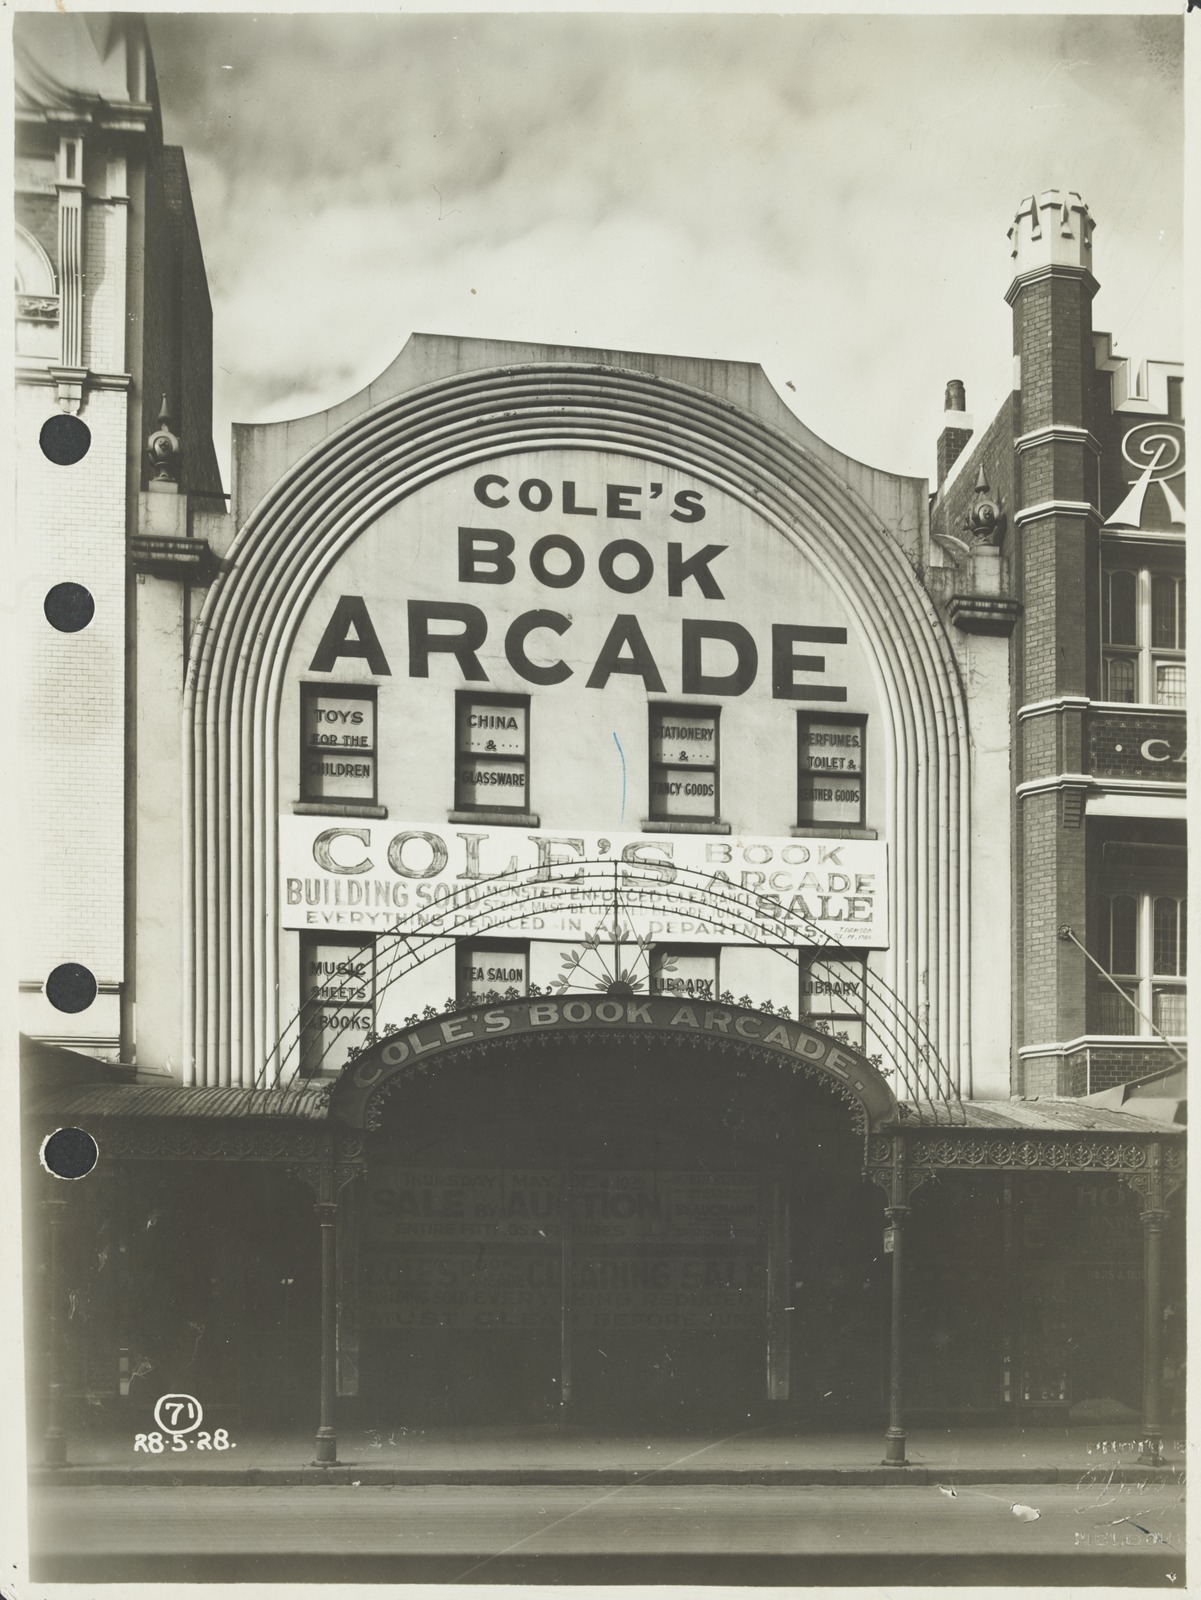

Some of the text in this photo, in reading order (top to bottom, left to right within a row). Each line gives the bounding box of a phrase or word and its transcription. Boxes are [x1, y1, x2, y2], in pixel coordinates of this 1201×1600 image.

[473, 473, 706, 523] COLE'S
[458, 526, 729, 600] BOOK
[308, 594, 847, 702] ARCADE
[314, 708, 365, 725] TOYS
[467, 714, 518, 730] CHINA
[311, 733, 370, 748] FOR THE
[654, 725, 714, 742] STATIONERY
[311, 762, 371, 778] CHILDREN
[808, 756, 845, 770] TOILET
[463, 770, 525, 787] GLASSWARE
[654, 781, 714, 797] FANCY GOODS
[834, 789, 860, 803] GOODS
[312, 828, 845, 888] COLE'S BOOK
[704, 870, 876, 895] ARCADE
[286, 878, 481, 911] BUILDING SOLD
[486, 884, 564, 900] MONSTER
[754, 894, 874, 923] SALE
[306, 911, 444, 928] EVERYTHING
[454, 914, 545, 930] REDUCED
[310, 961, 367, 977] MUSIC
[462, 966, 523, 983] TEA SALON
[311, 985, 367, 1000] SHEETS
[801, 980, 860, 996] LIBRARY
[320, 1014, 371, 1031] BOOKS
[353, 1009, 512, 1089] COLE'S
[529, 1001, 654, 1026] BOOK
